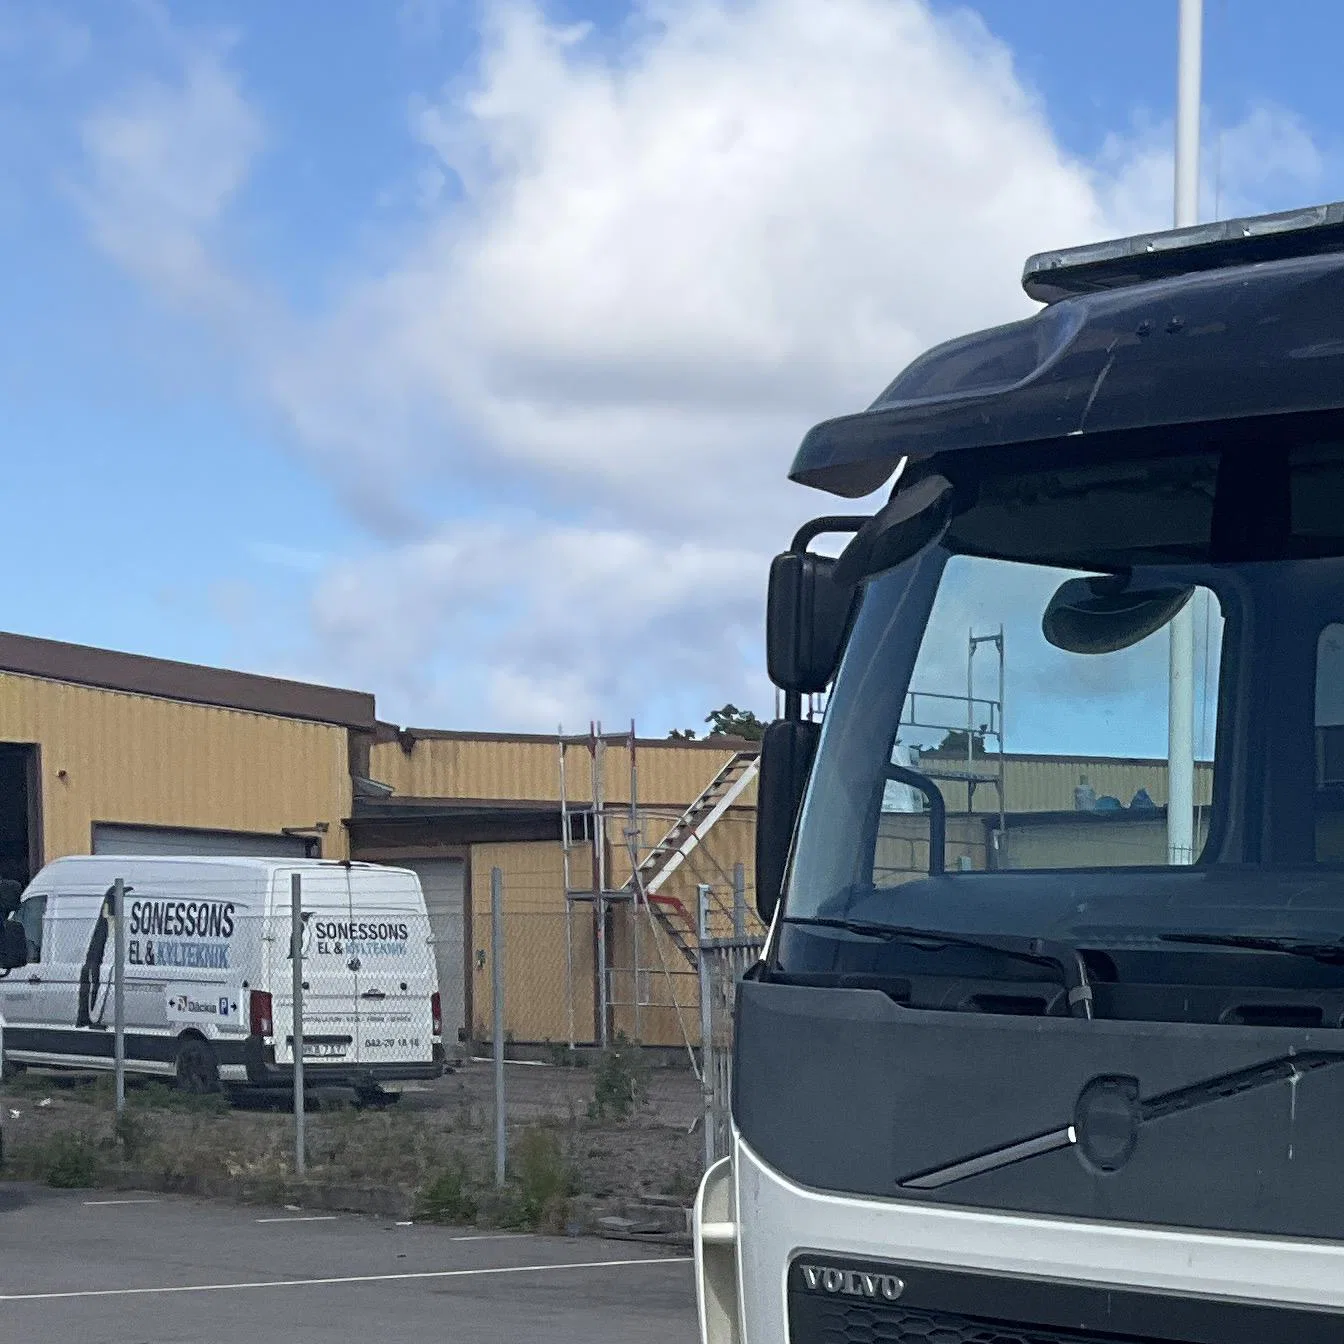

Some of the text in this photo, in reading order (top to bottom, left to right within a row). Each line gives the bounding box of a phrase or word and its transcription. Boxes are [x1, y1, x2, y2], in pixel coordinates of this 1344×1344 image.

[130, 901, 235, 938] SONESSONS
[315, 922, 408, 941] SONESSONS
[129, 940, 143, 965] EL
[145, 940, 155, 966] &
[318, 942, 330, 955] EL
[333, 942, 343, 955] &
[800, 1264, 905, 1301] VOLVO
